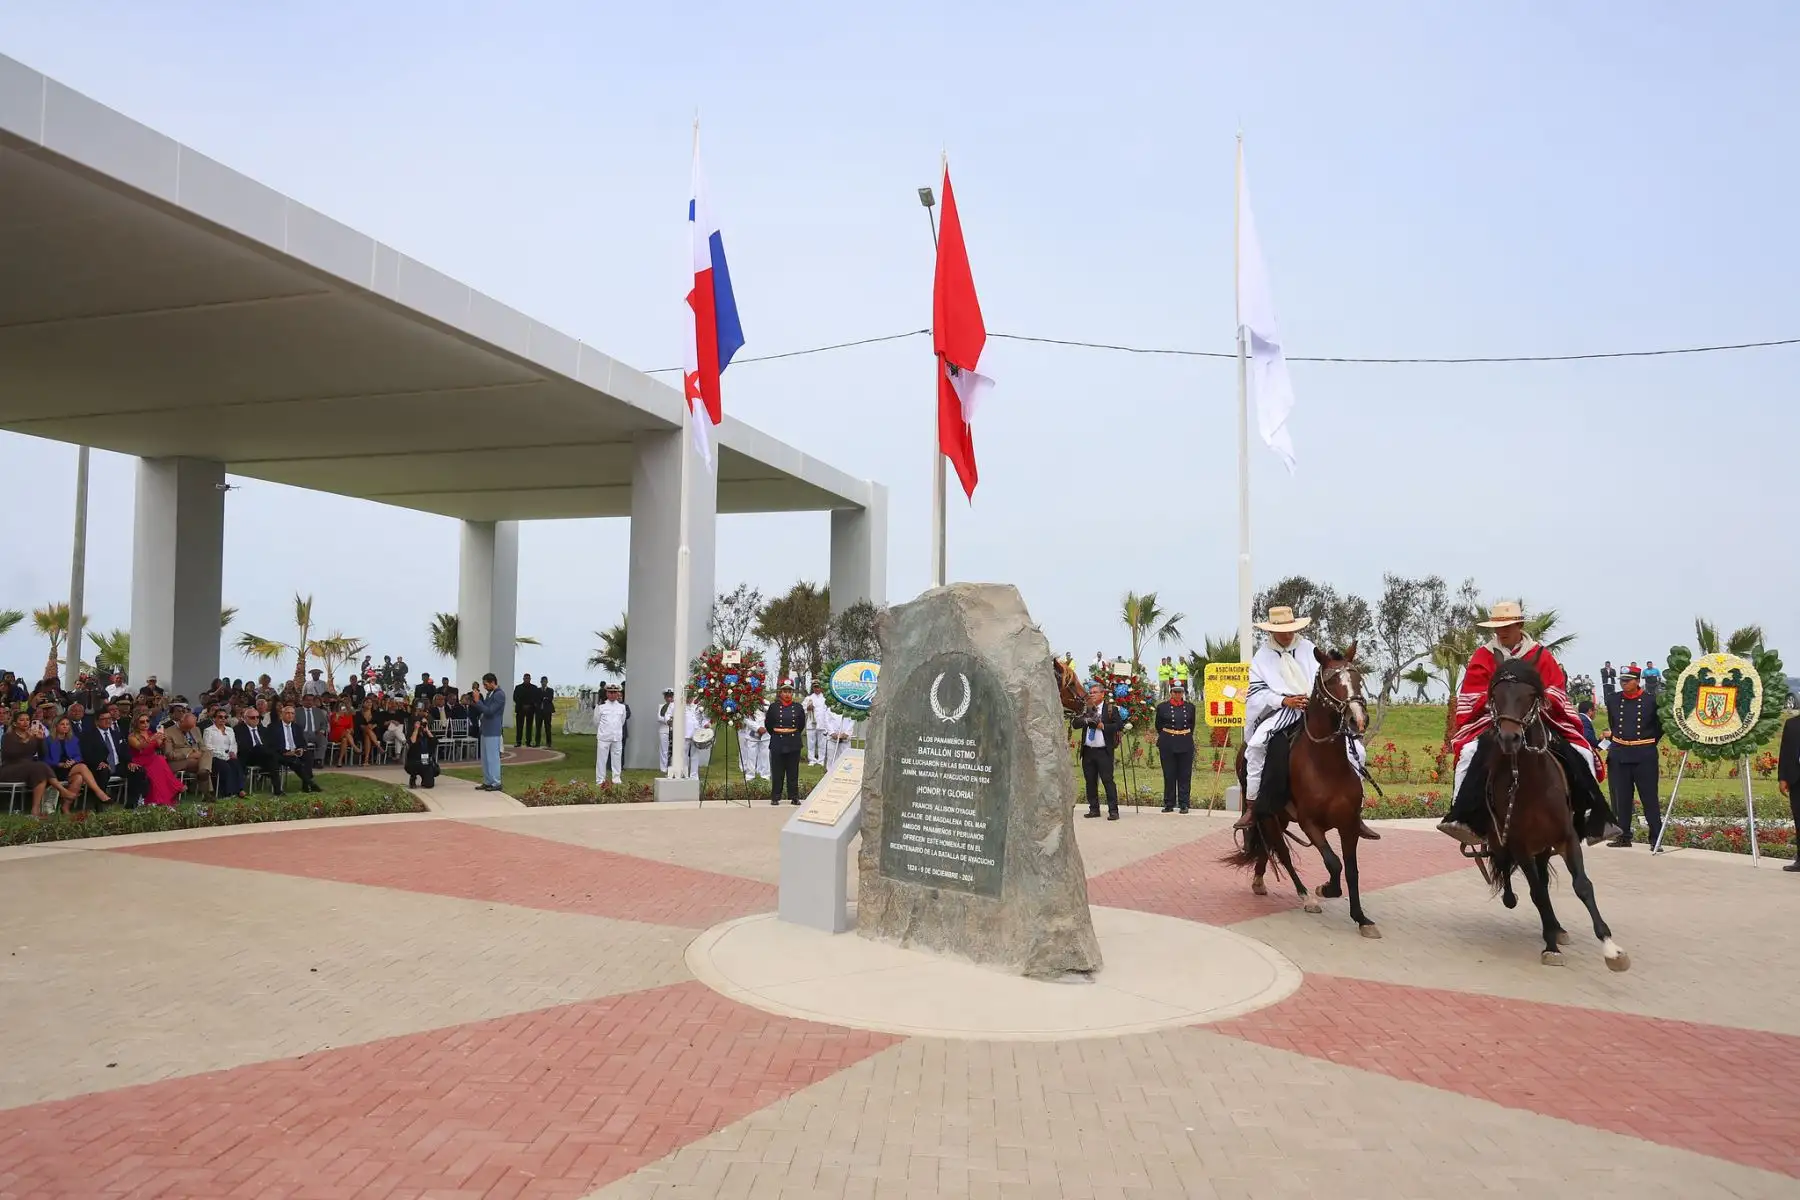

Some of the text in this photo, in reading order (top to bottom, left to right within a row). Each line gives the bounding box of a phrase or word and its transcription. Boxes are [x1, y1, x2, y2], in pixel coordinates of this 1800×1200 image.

[1675, 708, 1700, 740] COMUNIDAD
[1705, 712, 1755, 742] INTERNACIONAL
[918, 747, 975, 759] BATALLÓN ISTMO
[958, 763, 983, 772] BATALLAS
[943, 773, 969, 782] AYACUCHO
[917, 786, 940, 795] ¡HONOR
[948, 789, 973, 799] GLORIA!
[956, 807, 976, 816] OYAGUE
[902, 812, 923, 820] ALCALDE
[933, 816, 962, 825] MAGDALENA
[957, 830, 984, 840] PERUANOS
[903, 834, 925, 843] OFRECEN
[940, 839, 966, 849] HOMENAJE
[890, 843, 923, 854] BICENTENARIO
[939, 851, 959, 860] BATALLA
[968, 856, 994, 866] AYACUCHO
[932, 867, 958, 879] DICIEMBRE
